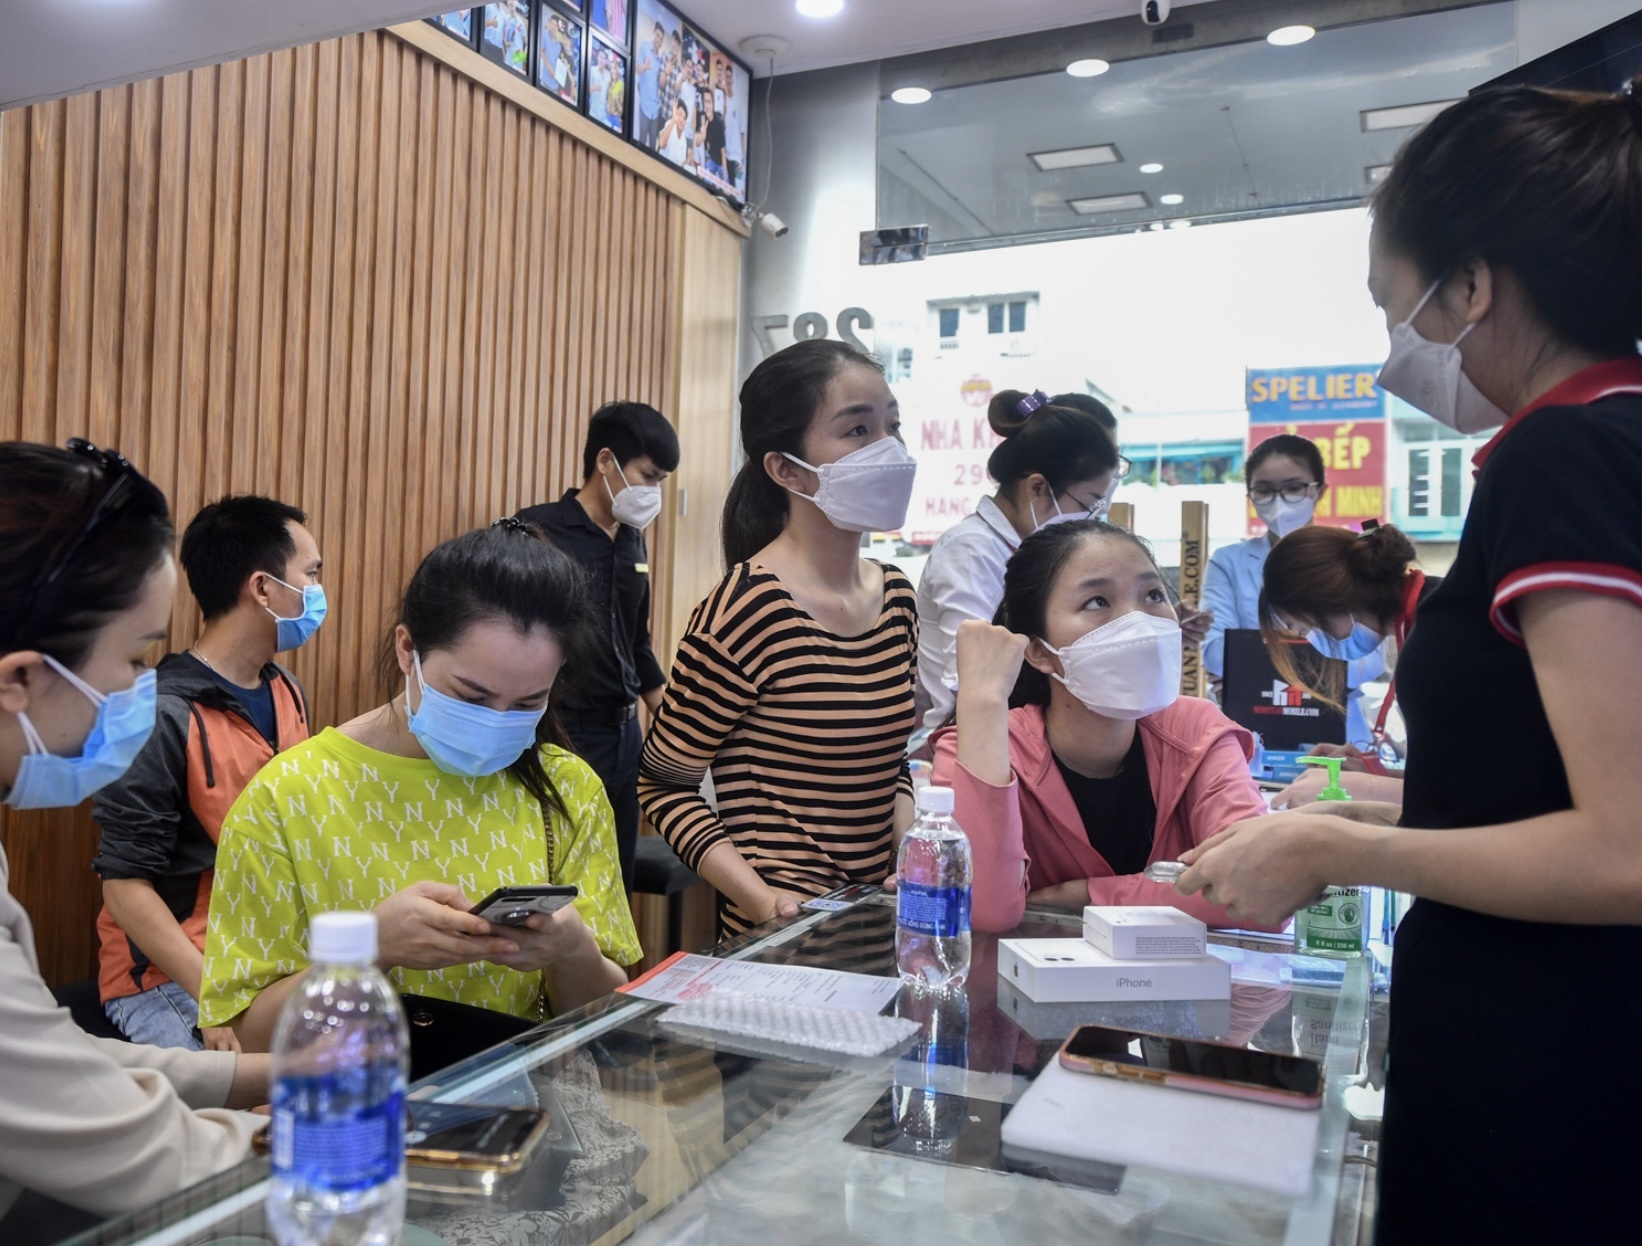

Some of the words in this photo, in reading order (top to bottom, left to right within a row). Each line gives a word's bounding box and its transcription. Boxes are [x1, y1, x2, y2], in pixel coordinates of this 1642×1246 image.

[1251, 372, 1378, 403] SPELIER
[1336, 485, 1383, 517] MINH
[281, 759, 300, 776] N
[322, 759, 340, 780] N
[361, 763, 380, 782] N
[264, 778, 280, 798] Y
[306, 774, 321, 795] Y
[343, 780, 359, 802] Y
[383, 781, 399, 803] Y
[424, 779, 440, 800] Y
[560, 779, 575, 798] N
[287, 794, 307, 817] N
[328, 794, 346, 815] N
[445, 797, 464, 818] N
[482, 790, 499, 811] N
[365, 801, 384, 822] N
[405, 801, 424, 822] N
[502, 806, 516, 826] Y
[311, 814, 327, 837] Y
[387, 821, 404, 842] Y
[427, 819, 444, 842] Y
[467, 813, 482, 834] Y
[294, 839, 312, 861] N
[333, 836, 352, 857] N
[411, 840, 431, 861] N
[450, 838, 469, 858] N
[489, 830, 508, 851] N
[589, 832, 602, 853] N
[230, 849, 243, 871] Y
[370, 842, 390, 862] N
[474, 852, 490, 872] Y
[568, 841, 584, 864] N
[261, 854, 276, 877] Y
[317, 858, 331, 880] Y
[356, 856, 372, 879] Y
[394, 861, 410, 880] Y
[434, 857, 451, 878] Y
[497, 865, 517, 886] N
[528, 857, 546, 881] N
[214, 869, 227, 891] N
[242, 873, 258, 895] N
[337, 879, 354, 900] N
[377, 877, 397, 898] N
[457, 872, 476, 893] N
[598, 871, 611, 892] N
[276, 880, 295, 902] N
[300, 882, 319, 904] N
[226, 892, 241, 915] Y
[260, 896, 272, 918] Y
[241, 916, 256, 938] N
[608, 908, 619, 930] N
[220, 935, 237, 957] Y
[258, 938, 275, 960] Y
[603, 931, 614, 950] Y
[232, 957, 252, 979] N
[427, 967, 444, 983] N
[468, 961, 486, 978] N
[212, 979, 228, 996] Y
[448, 978, 466, 1001] Y
[489, 974, 504, 996] Y
[1116, 977, 1152, 988] iPhone
